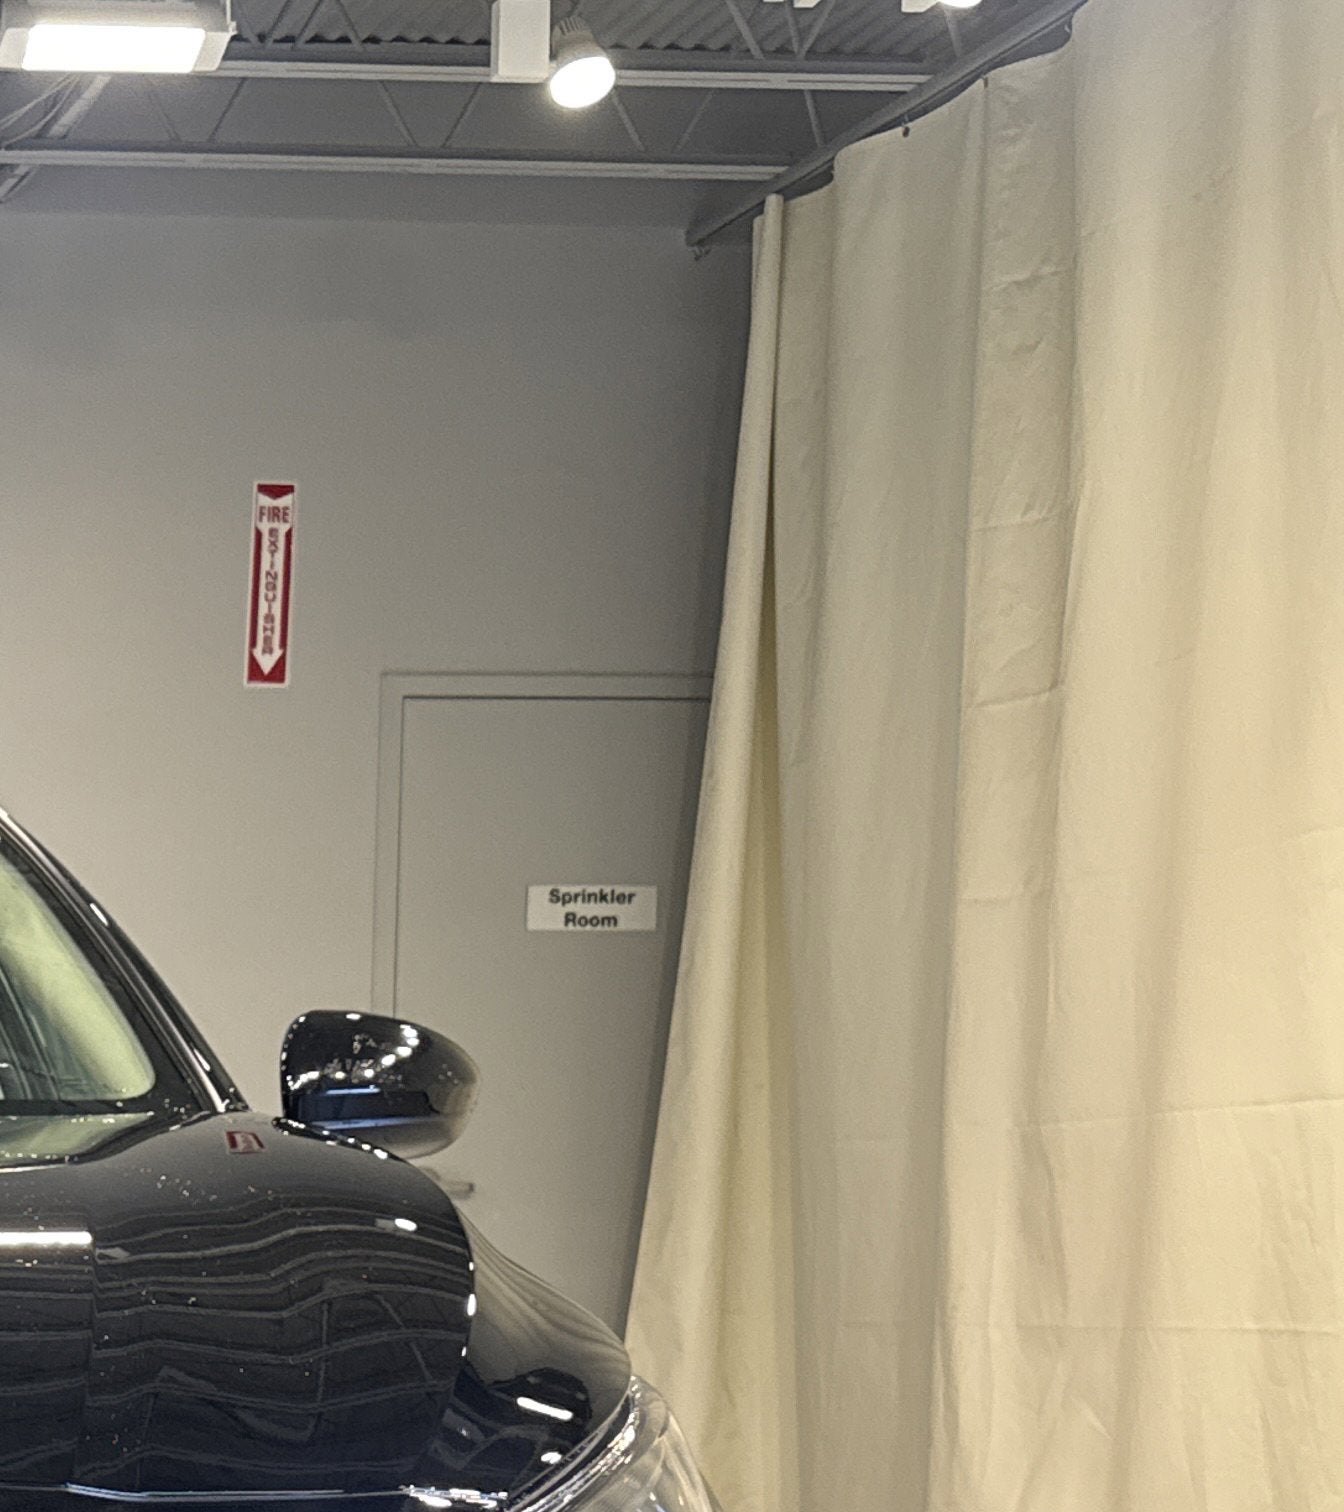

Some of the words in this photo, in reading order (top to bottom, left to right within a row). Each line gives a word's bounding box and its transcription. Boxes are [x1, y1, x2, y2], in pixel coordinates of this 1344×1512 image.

[258, 505, 291, 523] FIRE
[261, 527, 279, 655] EXTINGUISHER
[549, 888, 636, 907] Sprinkler
[564, 911, 619, 928] Room
